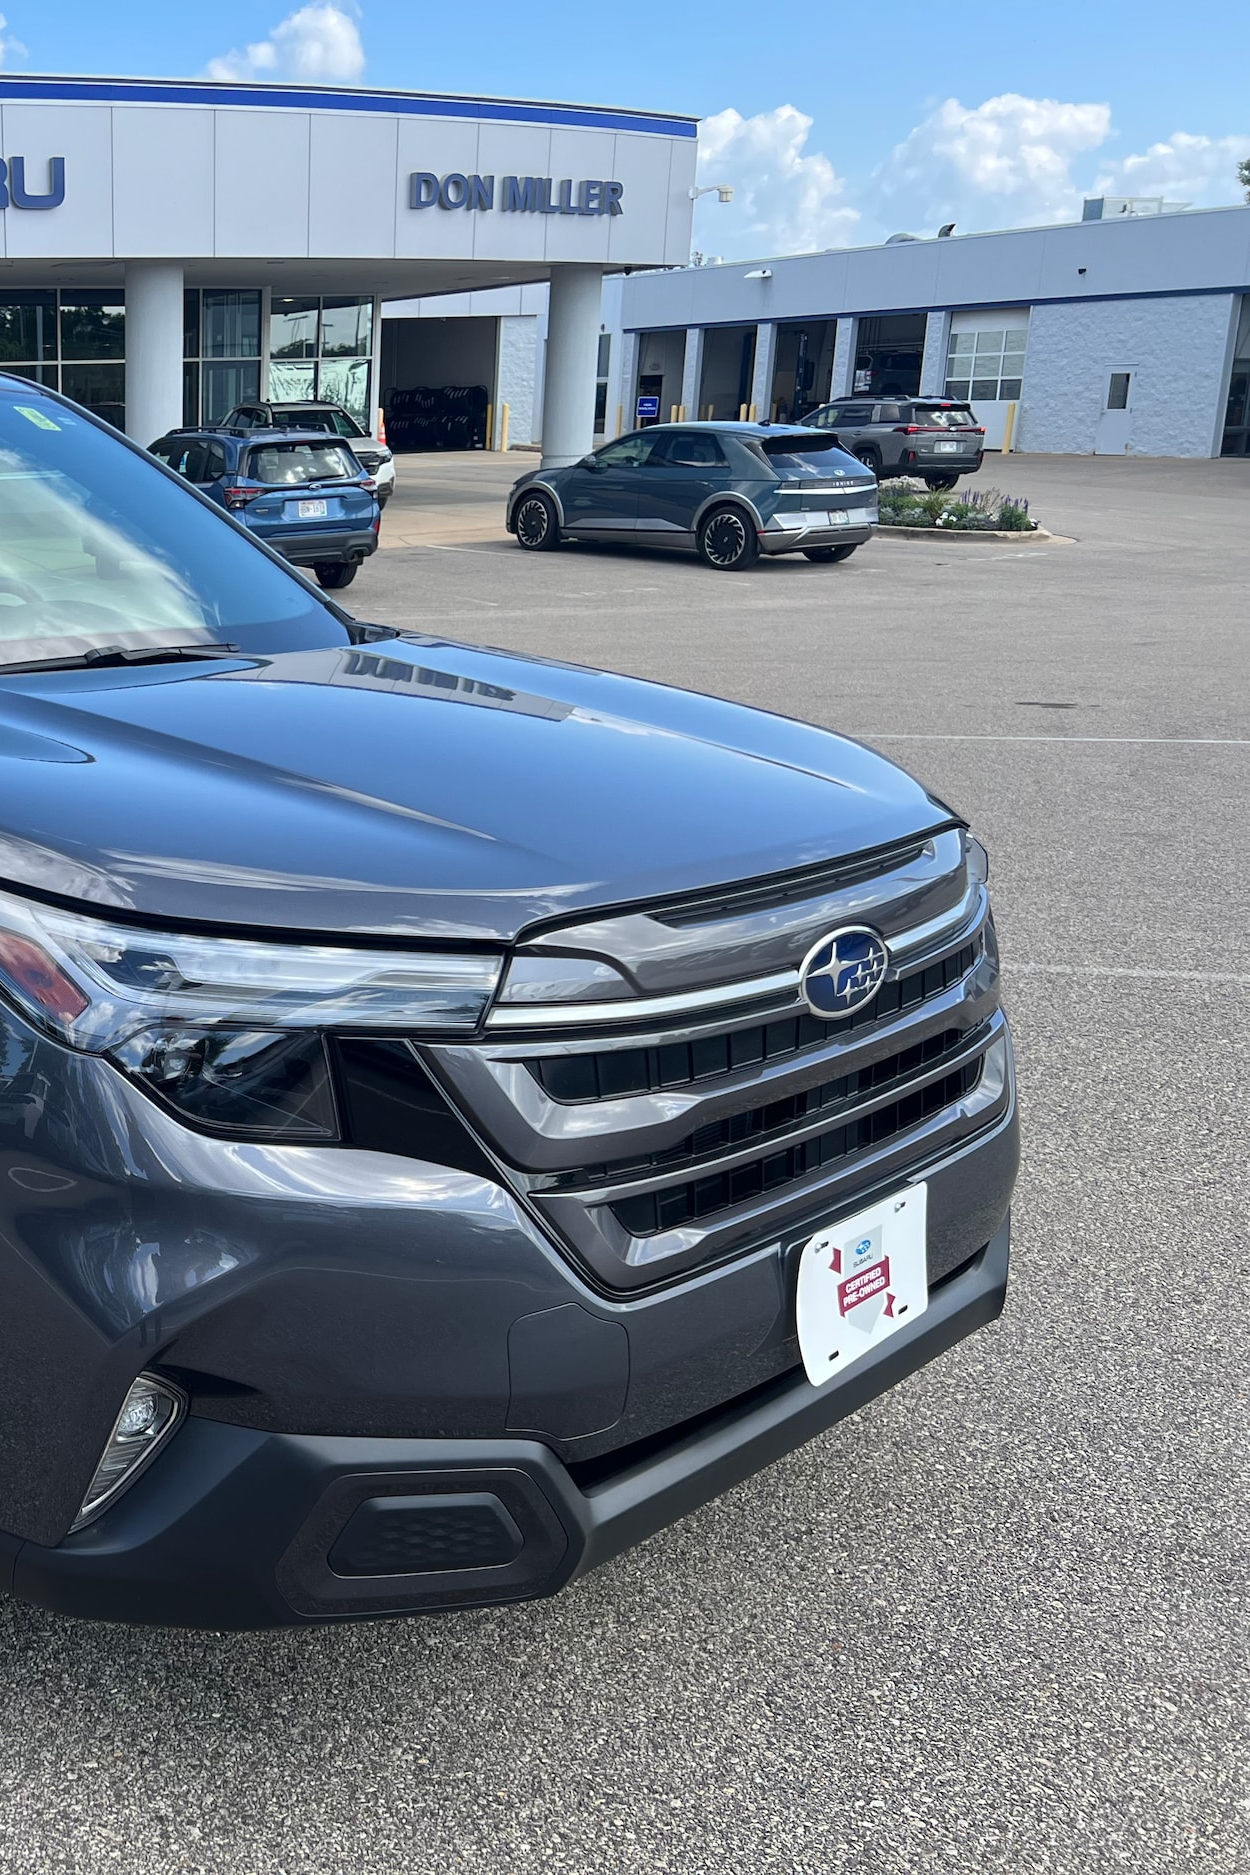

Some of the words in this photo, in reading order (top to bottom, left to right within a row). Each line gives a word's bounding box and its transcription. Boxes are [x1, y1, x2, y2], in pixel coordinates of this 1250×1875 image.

[409, 171, 495, 211] DON
[501, 175, 625, 216] MILLER
[853, 1254, 873, 1267] SUBARU
[843, 1276, 885, 1307] PRE-OWNED
[845, 1267, 881, 1293] CERTIFIED
